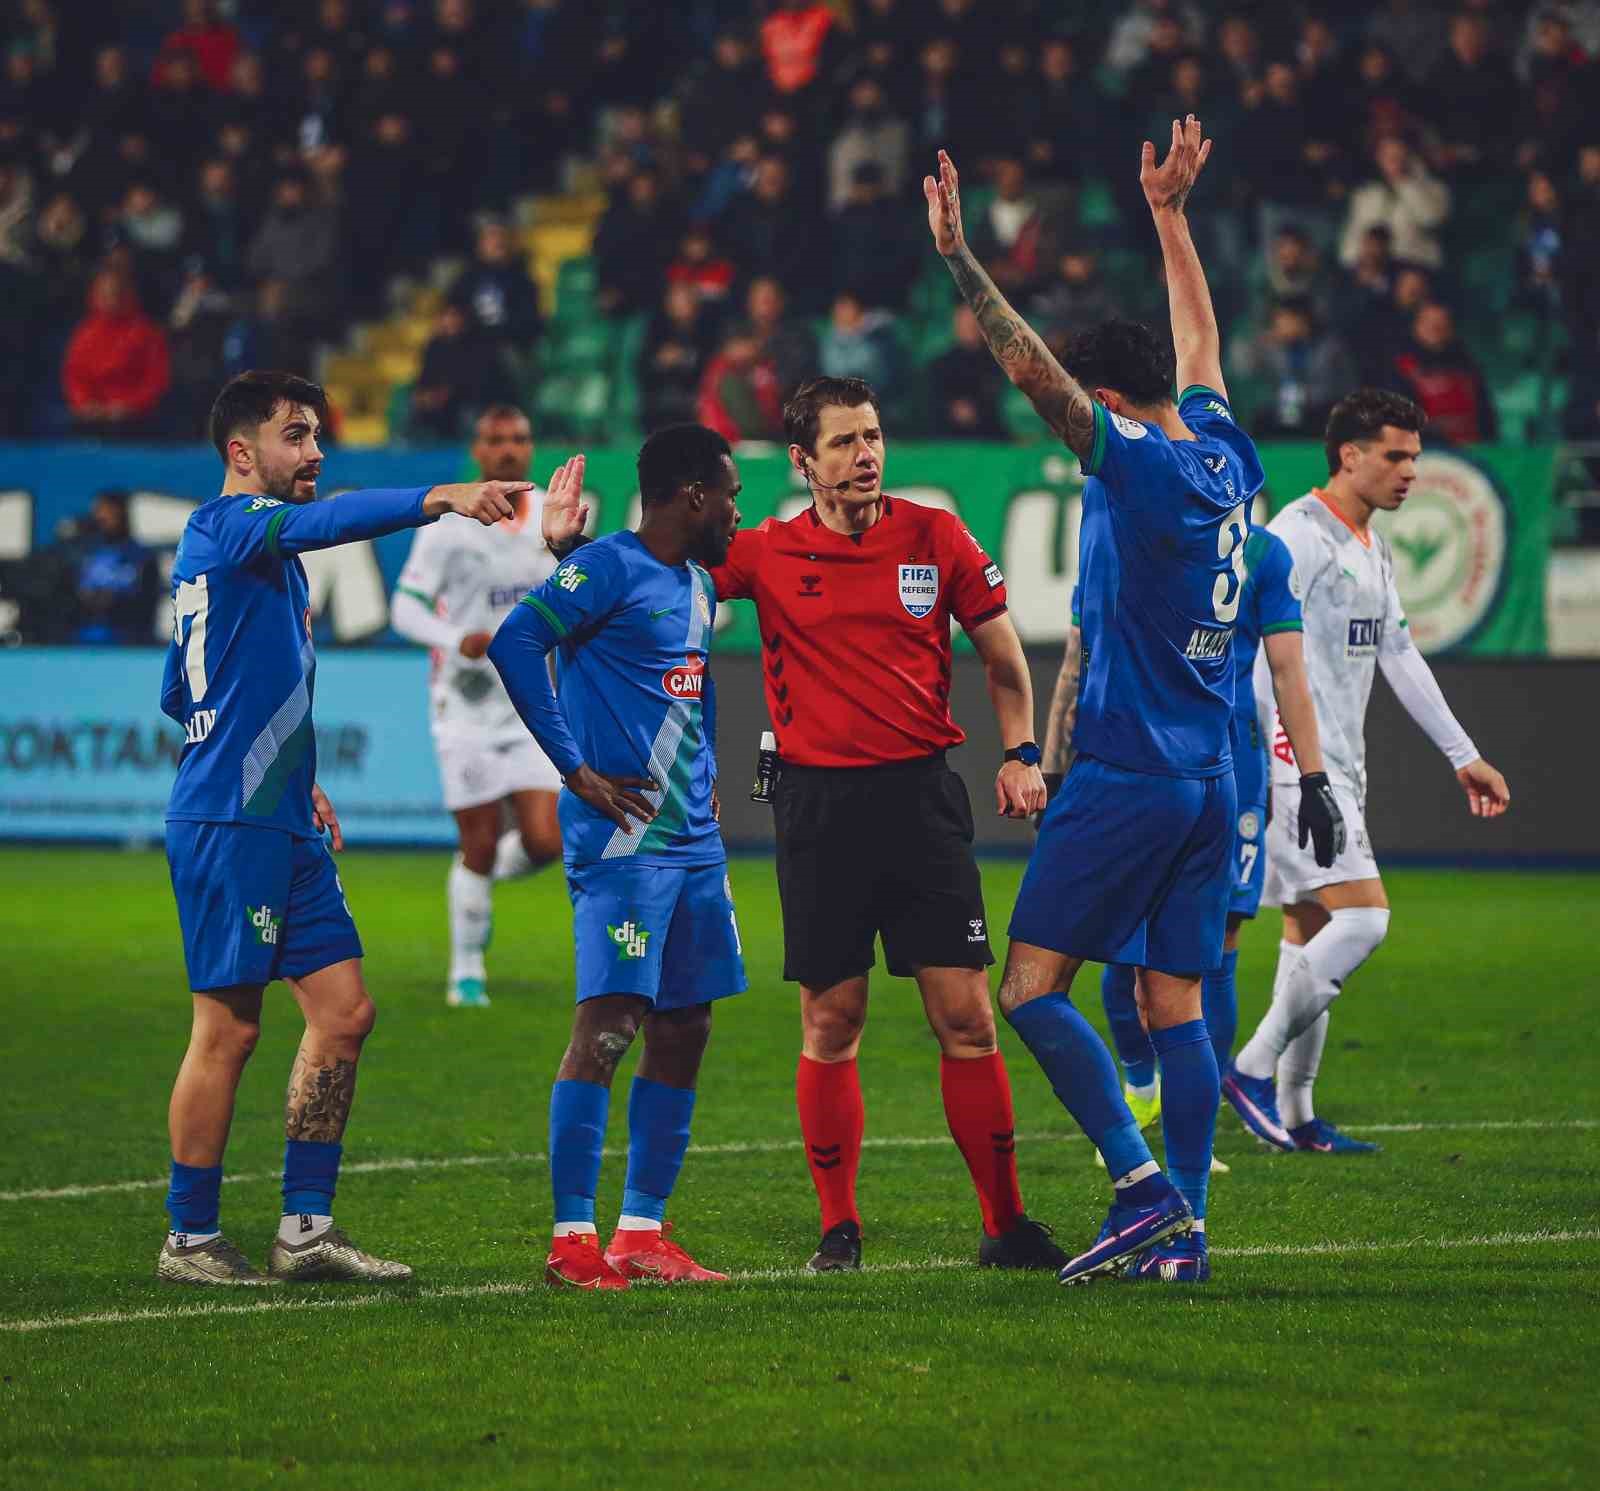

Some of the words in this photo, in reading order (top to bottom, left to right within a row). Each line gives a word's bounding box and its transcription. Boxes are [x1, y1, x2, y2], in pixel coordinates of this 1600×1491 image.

[902, 568, 933, 581] FIFA
[1212, 502, 1248, 623] 3
[902, 586, 936, 594] REFEREE
[1240, 843, 1259, 885] 7
